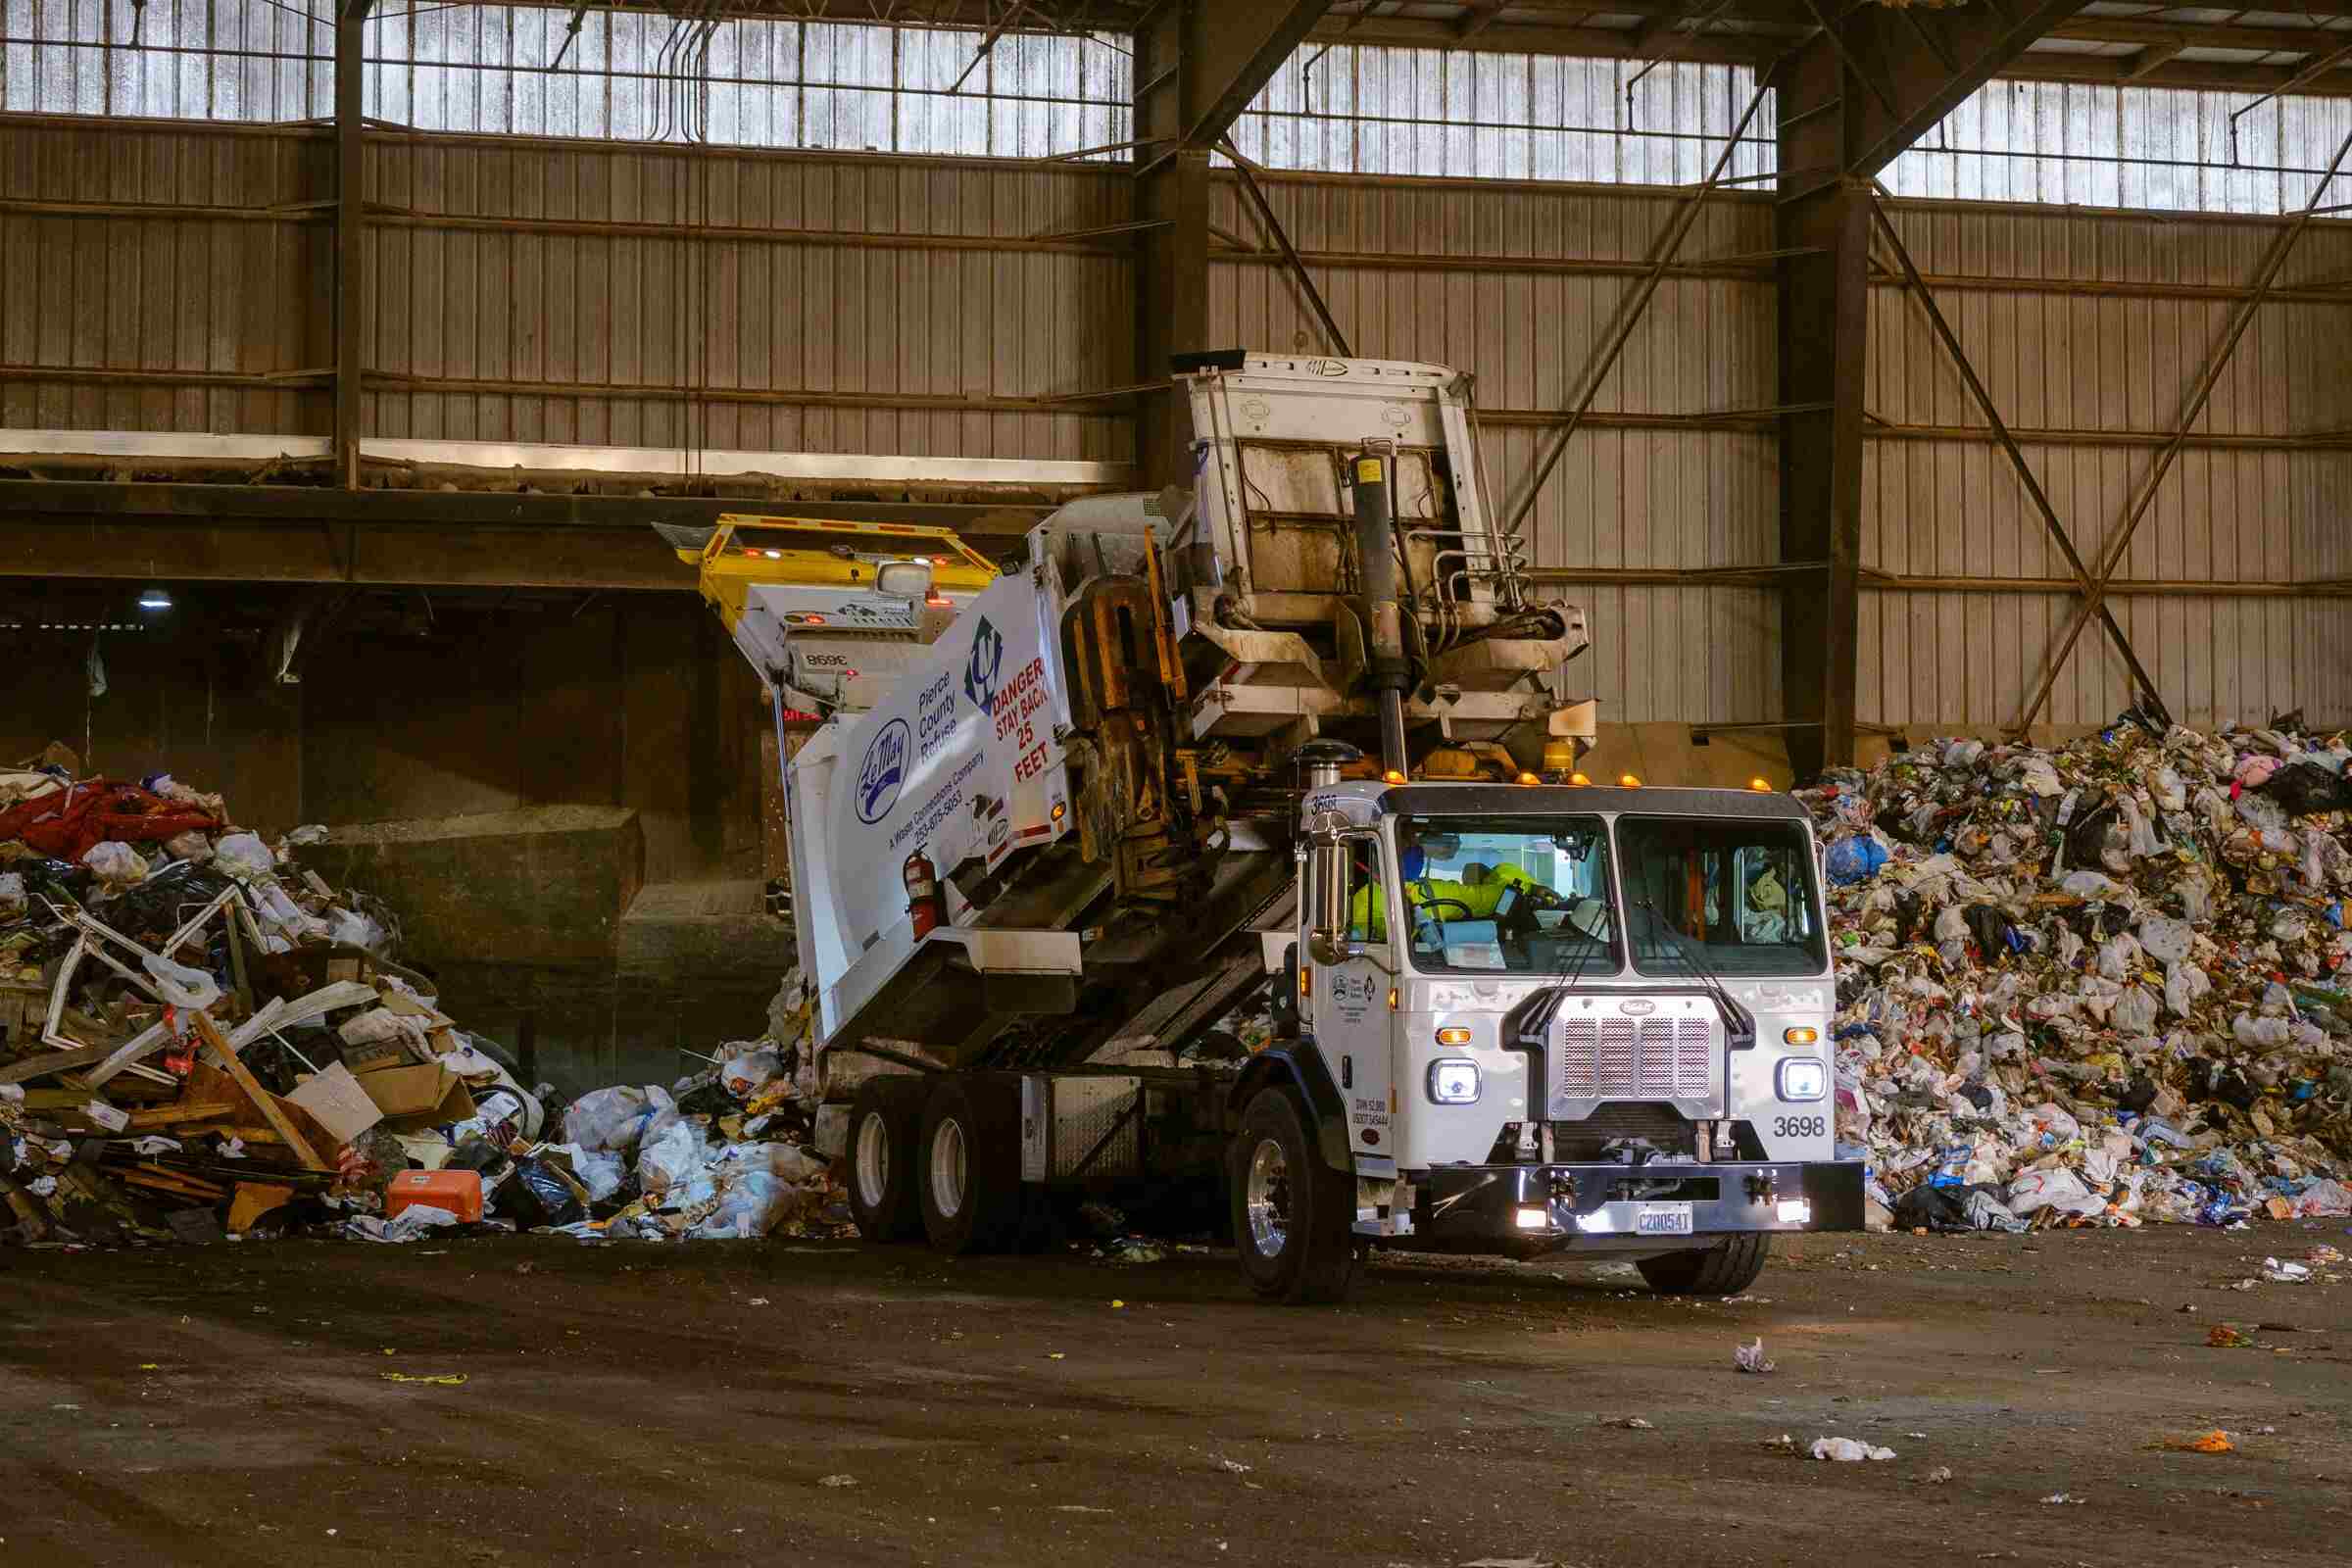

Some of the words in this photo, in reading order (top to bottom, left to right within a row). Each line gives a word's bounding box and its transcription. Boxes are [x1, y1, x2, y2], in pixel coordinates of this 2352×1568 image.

[918, 670, 949, 714] Pierce
[993, 657, 1045, 717] DANGER
[919, 690, 956, 738] County
[996, 706, 1019, 741] STAY
[1020, 684, 1049, 719] BACK
[920, 718, 956, 763] Refuse
[1017, 720, 1034, 750] 25
[1014, 741, 1049, 784] FEET
[1774, 1116, 1825, 1137] 3698
